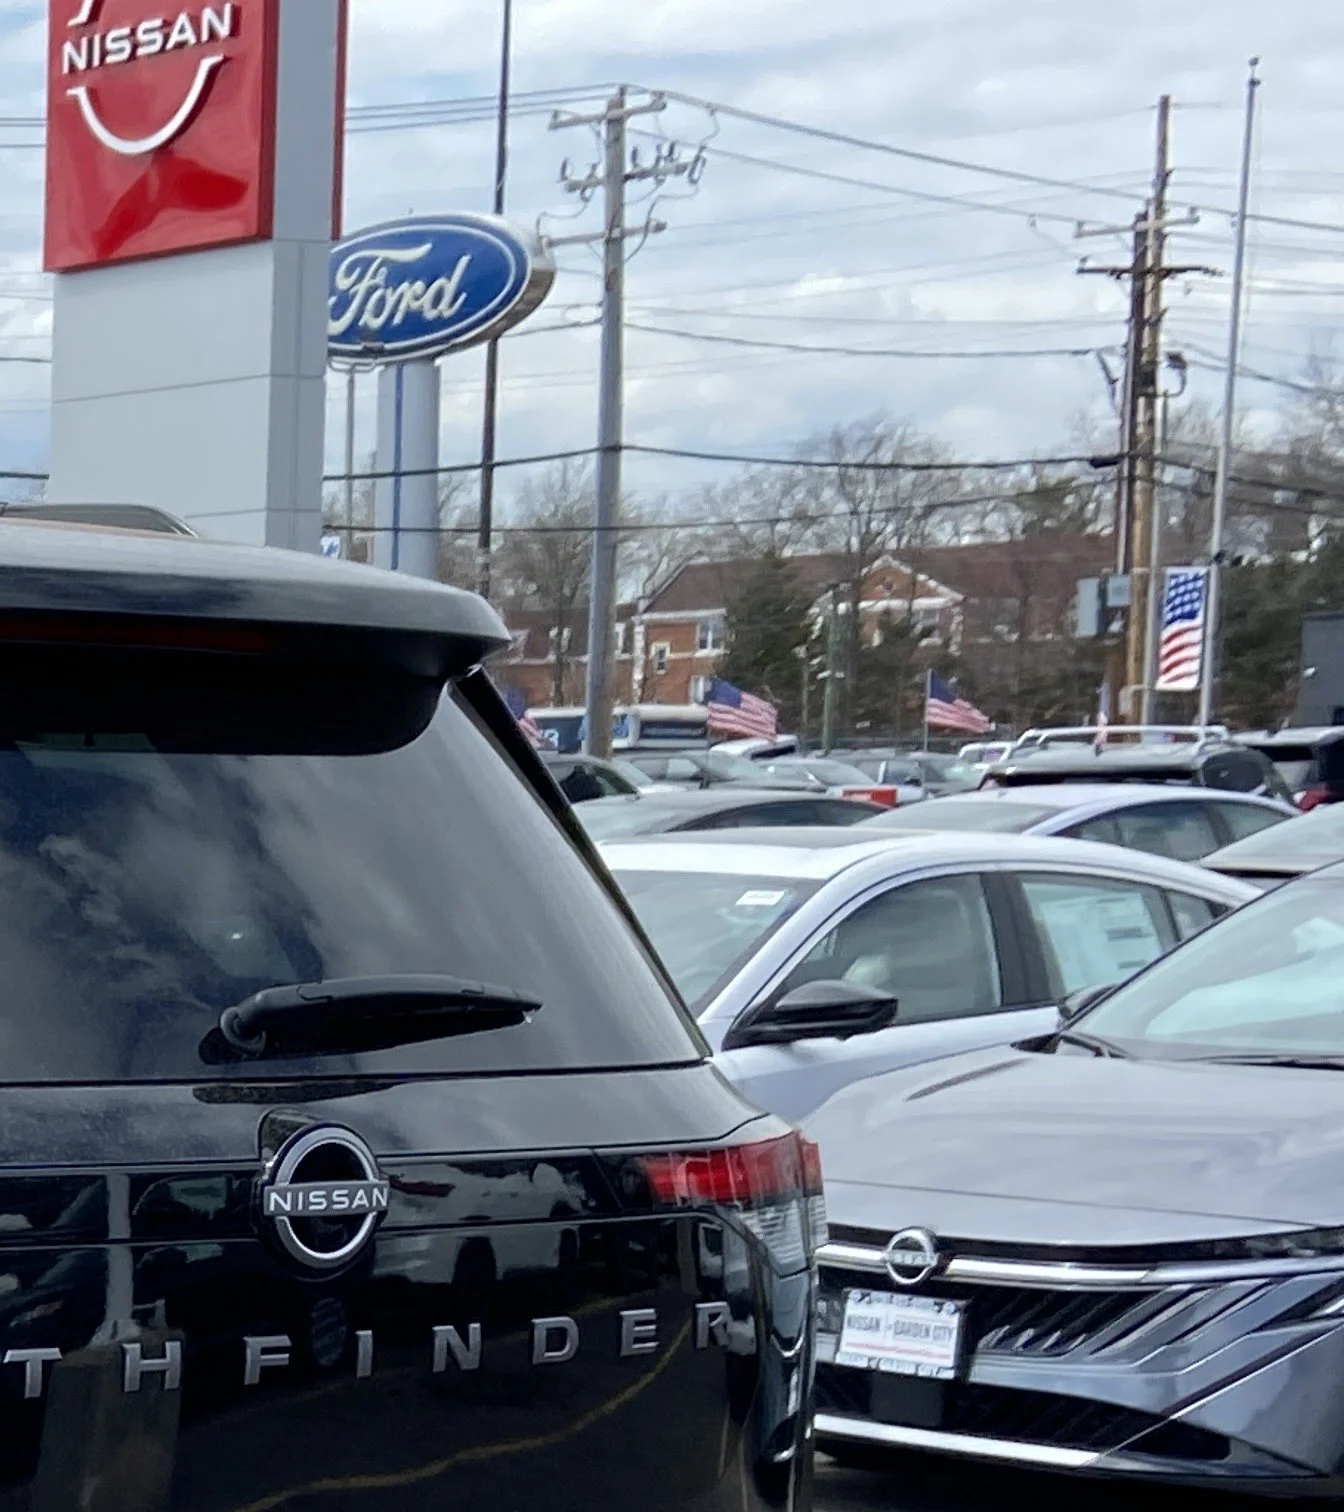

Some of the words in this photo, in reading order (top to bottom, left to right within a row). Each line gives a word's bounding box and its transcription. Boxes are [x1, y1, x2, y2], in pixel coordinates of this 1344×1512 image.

[61, 2, 233, 75] NISSAN
[327, 242, 472, 336] Ford
[268, 1187, 389, 1212] NISSAN
